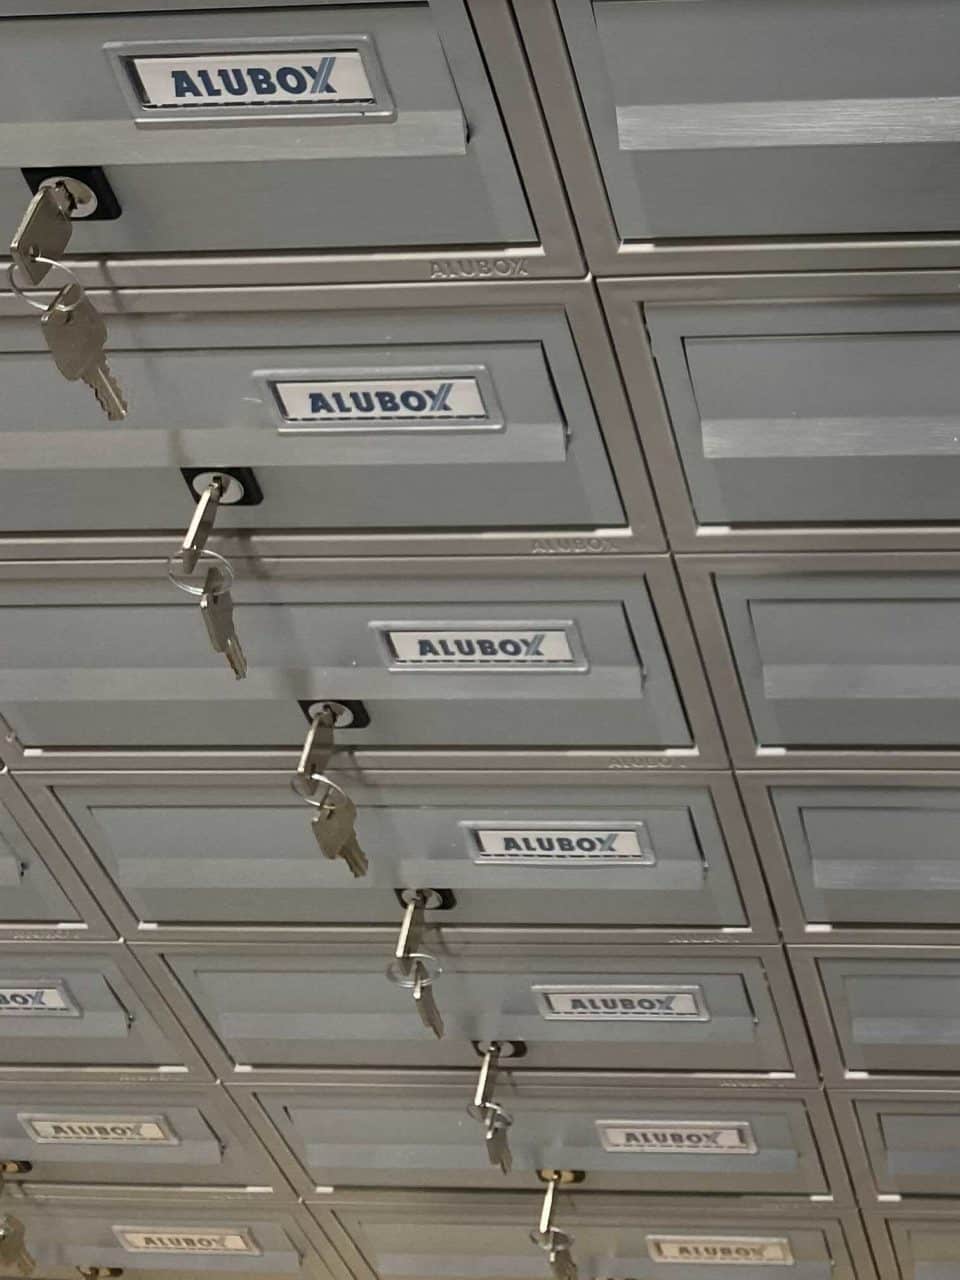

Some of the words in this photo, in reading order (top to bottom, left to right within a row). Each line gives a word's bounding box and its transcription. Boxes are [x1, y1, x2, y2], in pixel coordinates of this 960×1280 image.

[172, 57, 336, 97] ALUBOX
[430, 260, 528, 280] ALUBOX
[309, 384, 453, 412] ALUBOX
[418, 633, 546, 657] ALUBOX
[503, 833, 619, 852] ALUBOX
[571, 995, 676, 1012] ALUBOX
[52, 1124, 143, 1138] ALUBOX
[624, 1131, 722, 1145] ALUBOX
[143, 1235, 226, 1249] ALUBOX
[678, 1244, 763, 1257] ALUBOX
